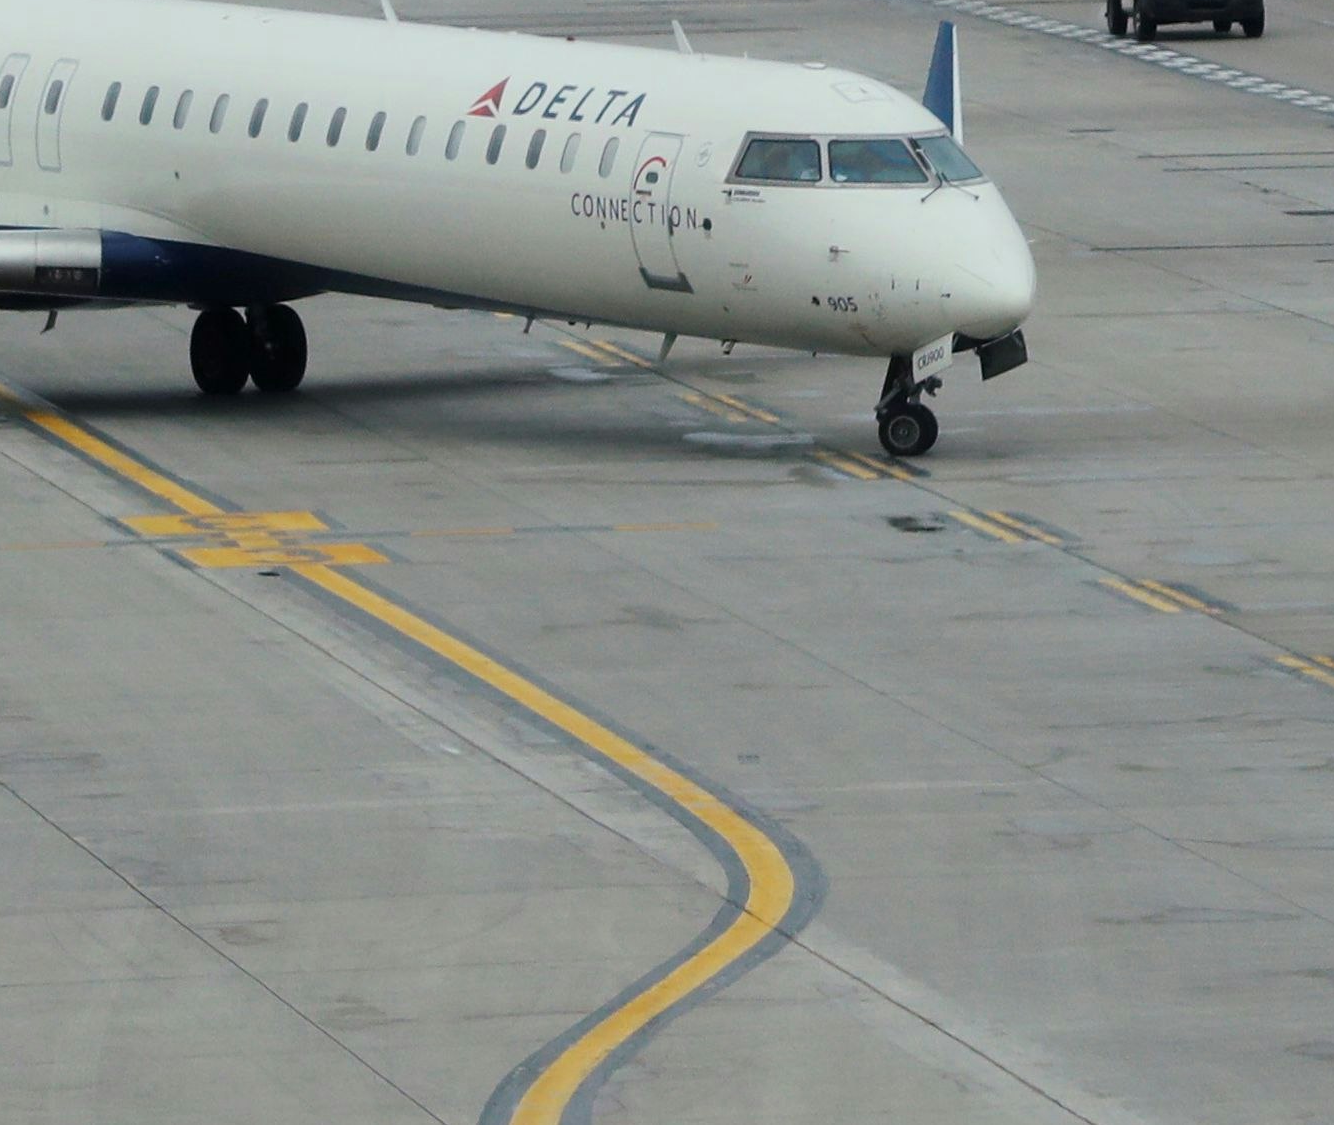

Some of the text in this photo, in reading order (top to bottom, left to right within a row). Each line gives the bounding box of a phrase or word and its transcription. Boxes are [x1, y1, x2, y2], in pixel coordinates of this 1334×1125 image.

[512, 81, 647, 127] DELTA
[571, 192, 697, 229] CONNECTION
[827, 296, 859, 313] 905
